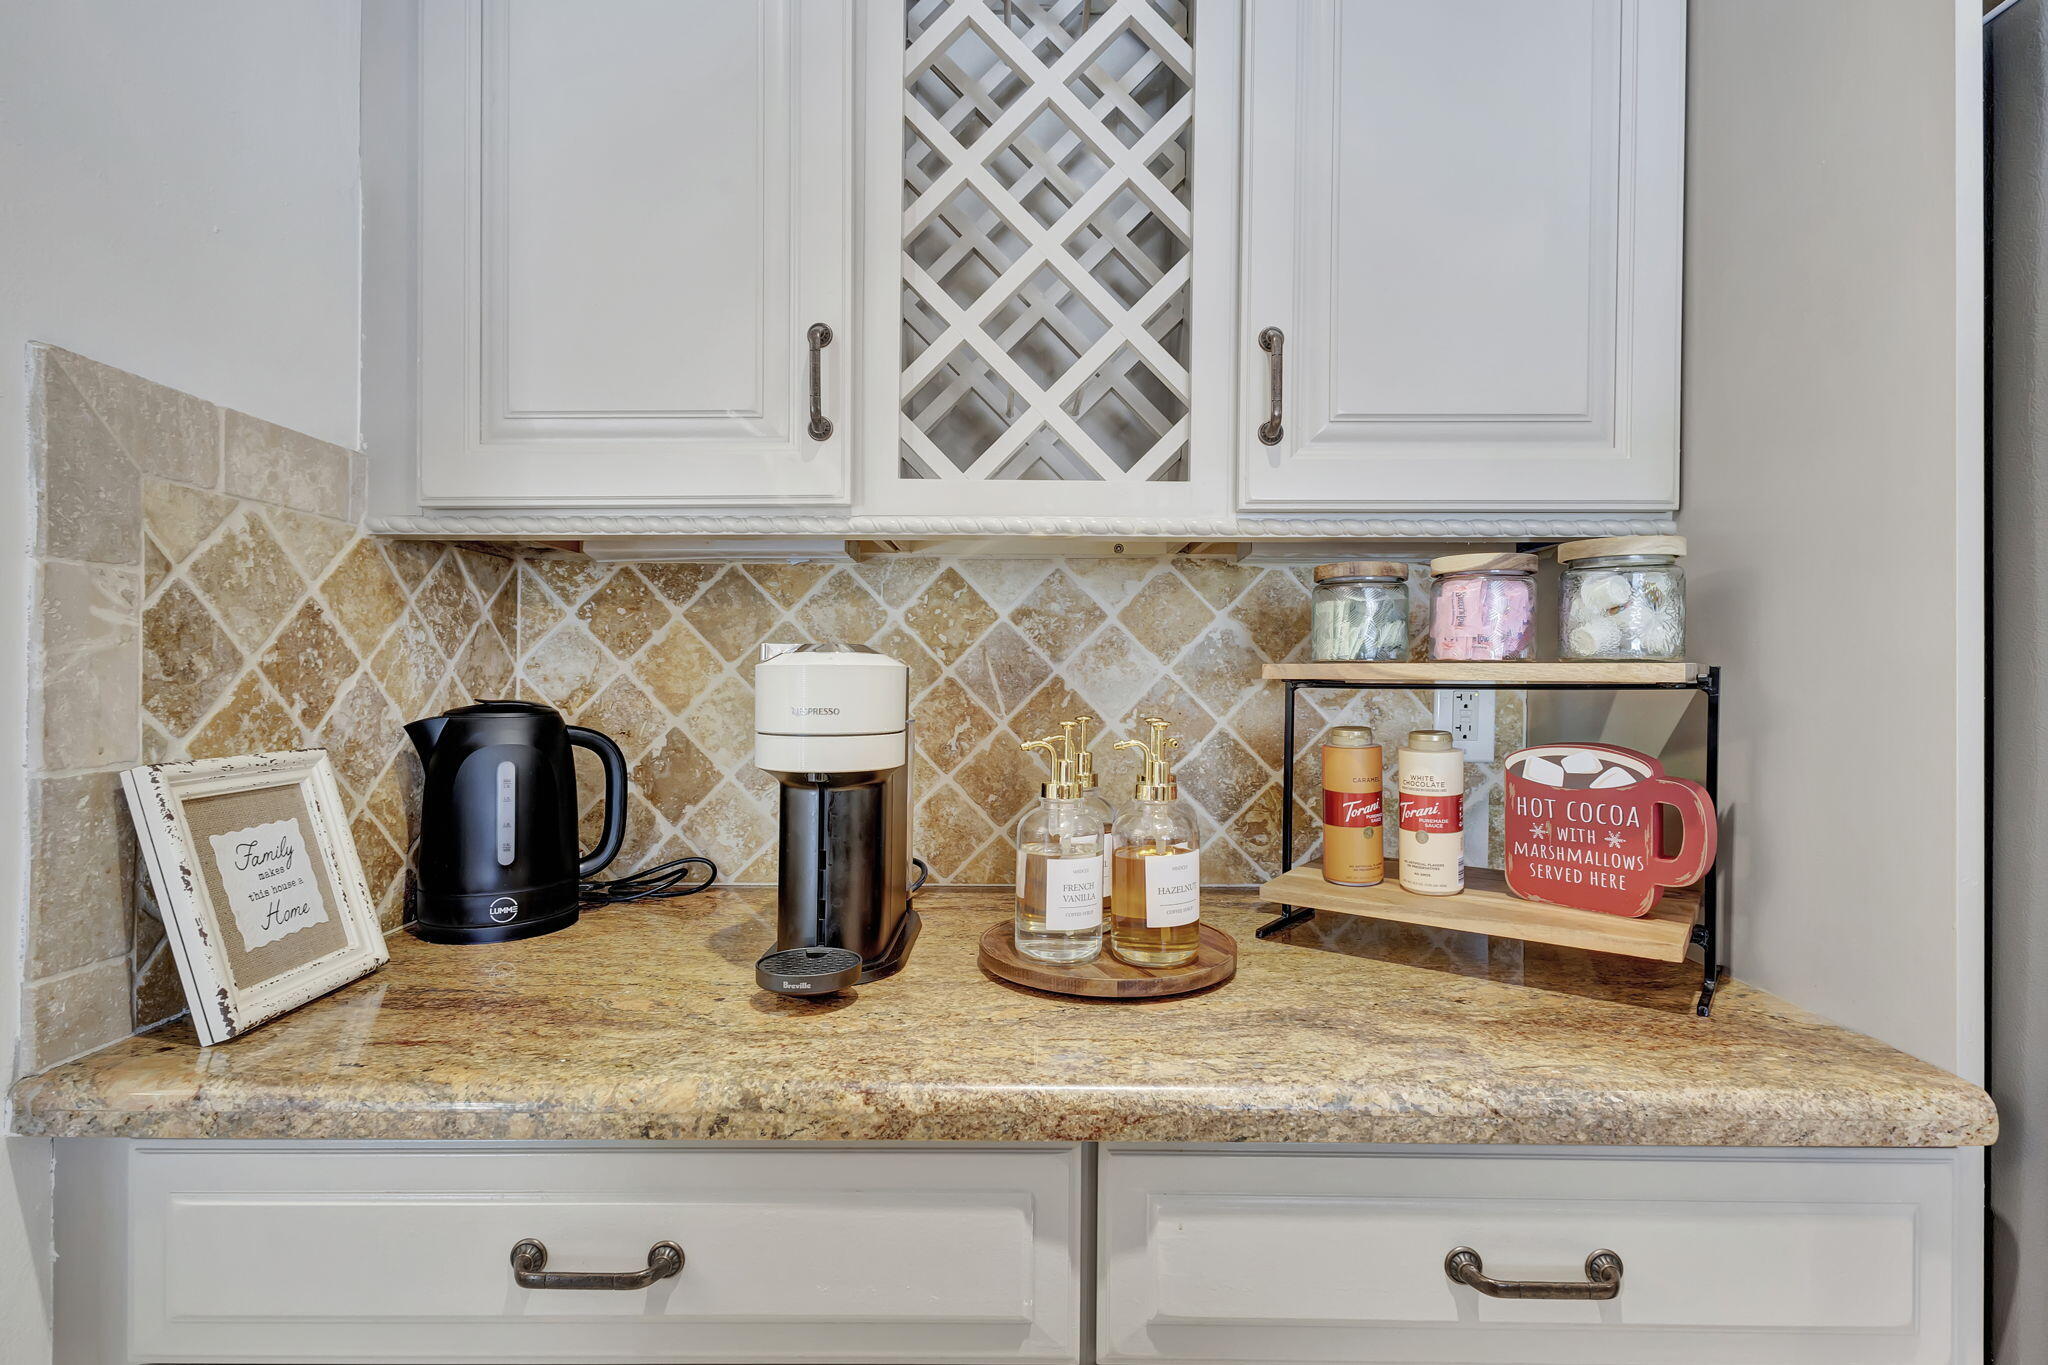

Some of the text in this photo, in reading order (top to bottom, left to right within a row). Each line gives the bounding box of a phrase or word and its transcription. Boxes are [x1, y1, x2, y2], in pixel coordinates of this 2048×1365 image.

[1402, 779, 1446, 788] CHOCOLATE
[1410, 774, 1434, 782] WHITE
[1342, 798, 1380, 823] Torani
[1399, 802, 1440, 823] Torani
[1517, 796, 1640, 828] HOT COCOA
[1556, 827, 1596, 845] WITH
[234, 835, 295, 871] Family
[1514, 841, 1645, 872] MARSHMALLOWS
[258, 866, 286, 880] makes
[1529, 862, 1626, 891] SERVED HERE
[248, 889, 270, 902] this
[271, 880, 297, 894] house
[1063, 882, 1096, 892] FRENCH
[1062, 892, 1097, 903] VANILLA
[261, 898, 311, 931] Home
[489, 905, 519, 915] LUMME
[782, 981, 813, 990] Breville
